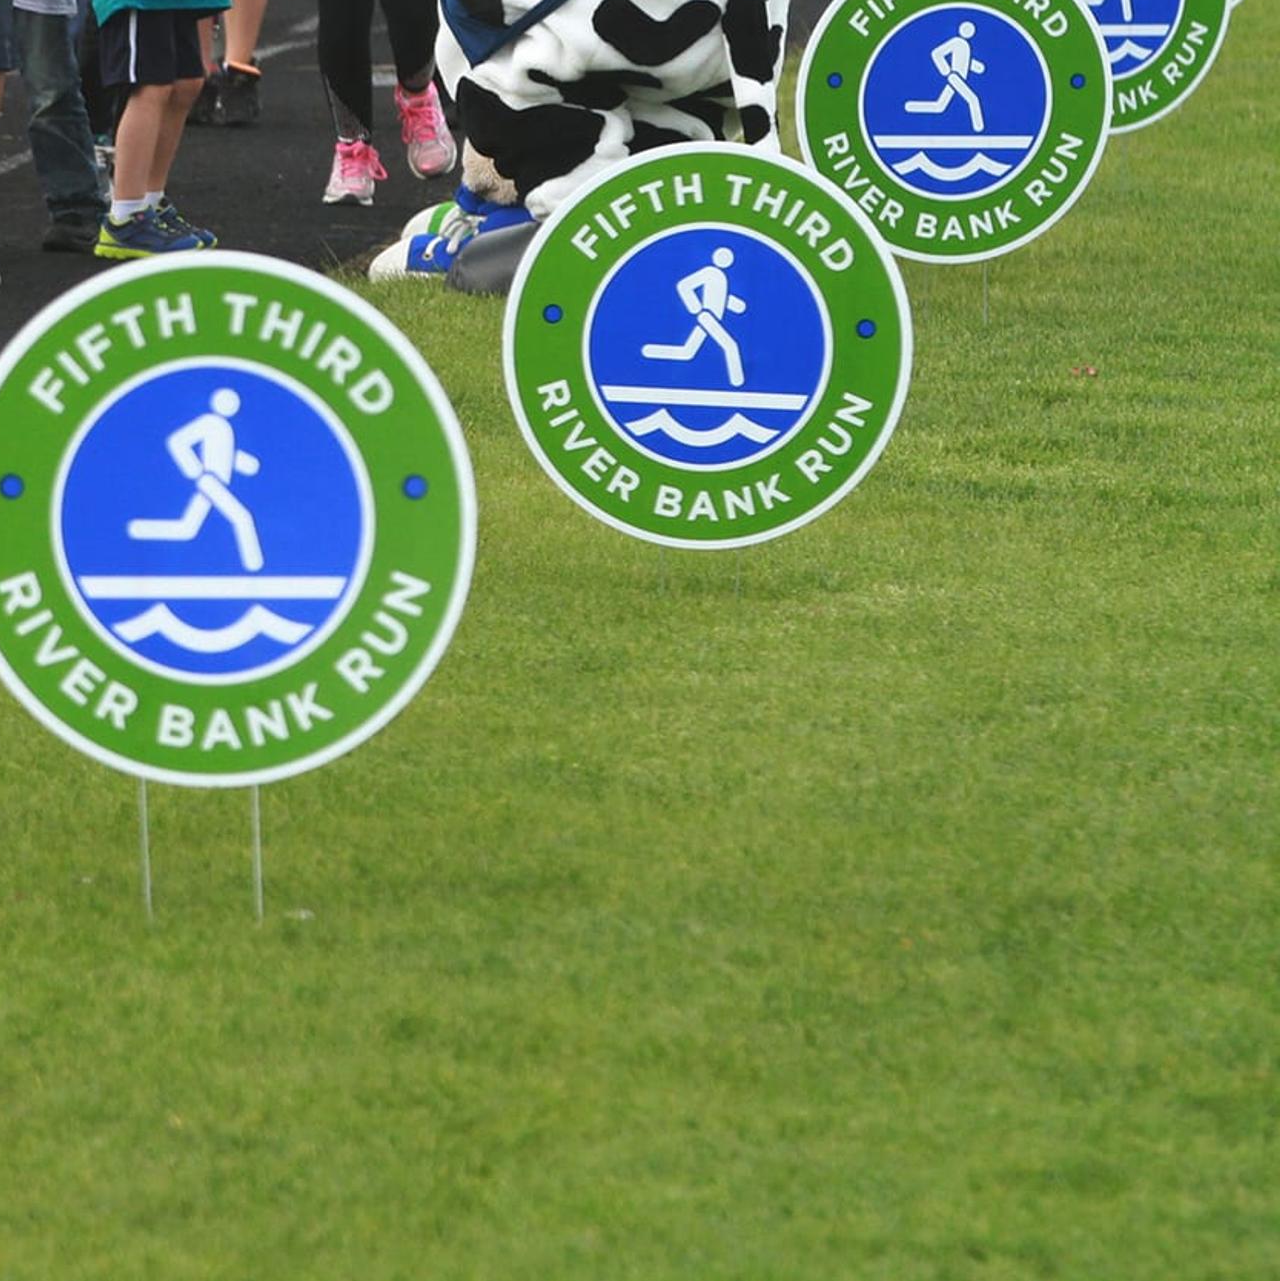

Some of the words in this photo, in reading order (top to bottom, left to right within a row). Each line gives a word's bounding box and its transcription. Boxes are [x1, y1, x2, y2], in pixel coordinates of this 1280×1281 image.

[1114, 80, 1159, 114] NK
[1161, 21, 1209, 85] RUN
[571, 172, 704, 261] FIFTH
[726, 174, 854, 272] THIRD
[824, 132, 905, 228] RIVER
[915, 199, 1021, 240] BANK
[1024, 132, 1084, 207] RUN
[28, 293, 197, 414] FIFTH
[222, 293, 394, 415] THIRD
[537, 379, 641, 502] RIVER
[654, 473, 792, 521] BANK
[795, 393, 873, 484] RUN
[157, 683, 334, 751] BANK
[334, 570, 432, 694] RUN
